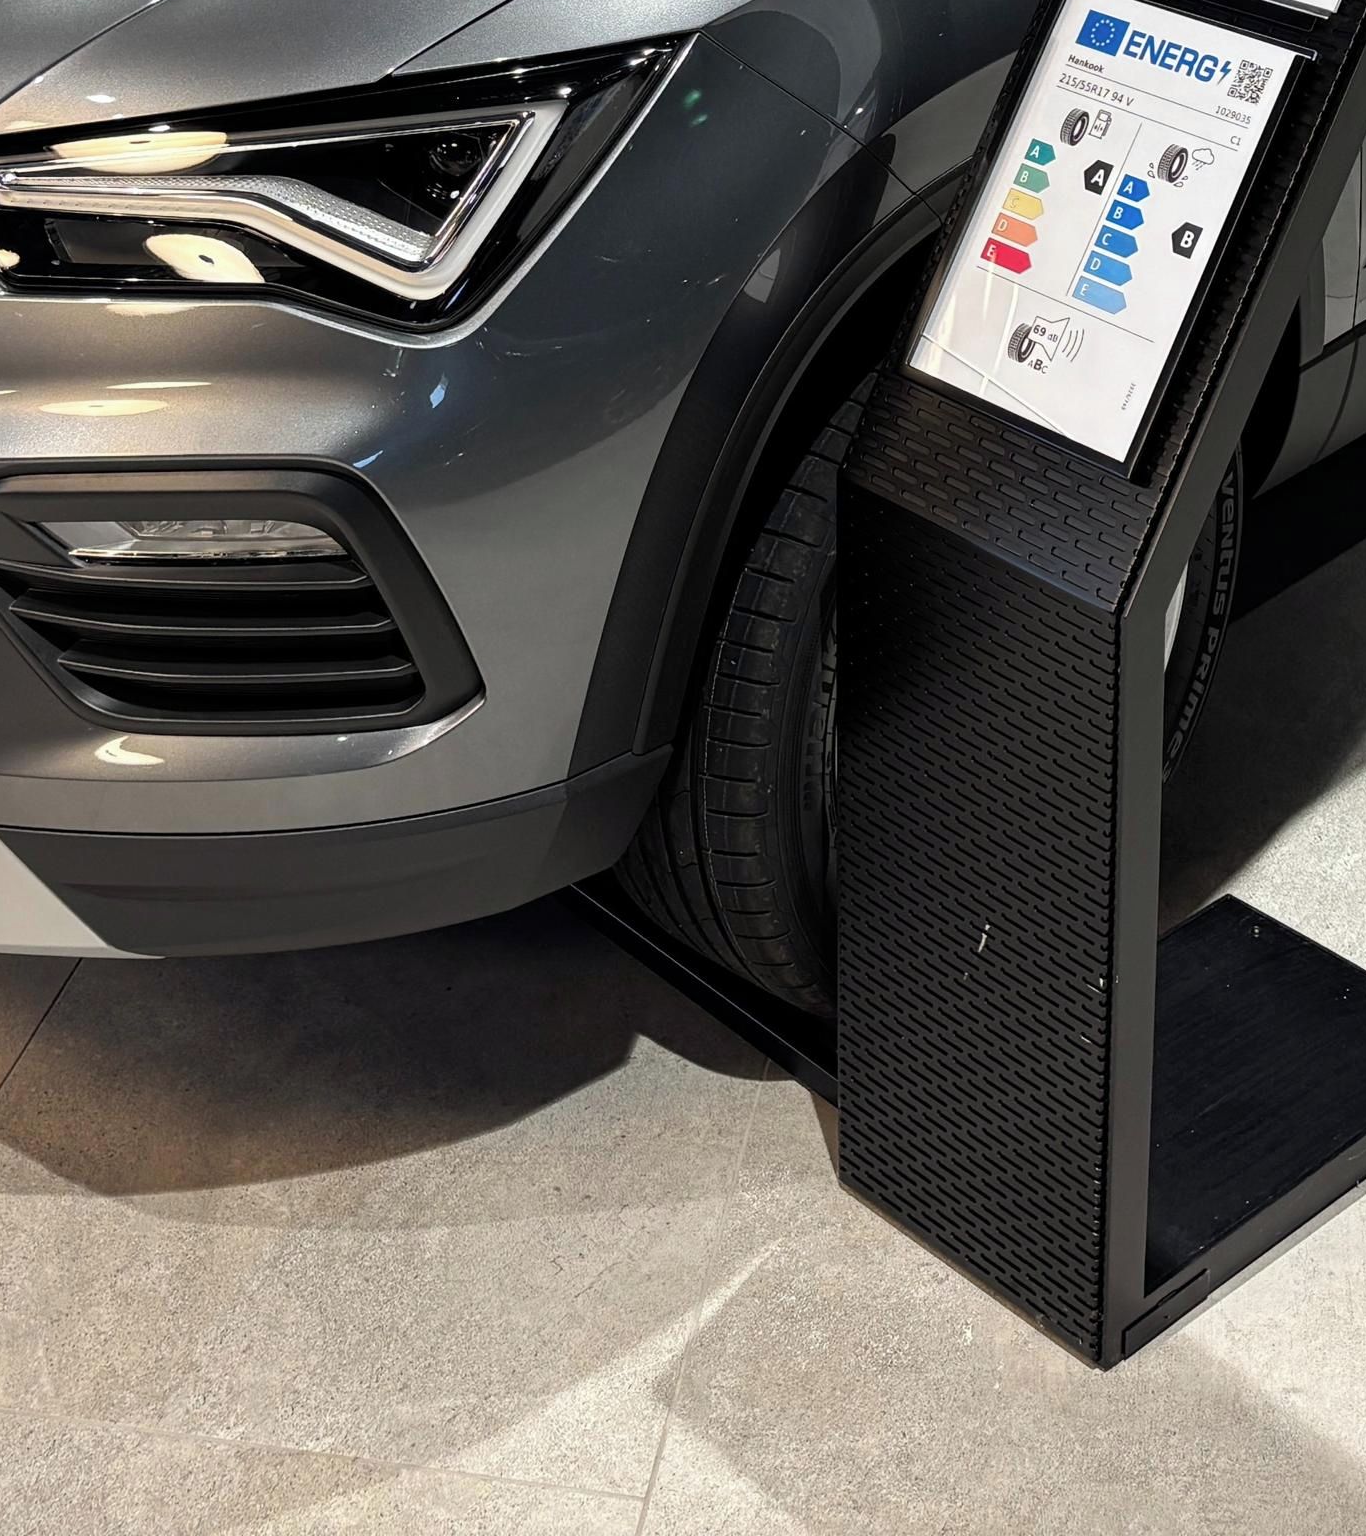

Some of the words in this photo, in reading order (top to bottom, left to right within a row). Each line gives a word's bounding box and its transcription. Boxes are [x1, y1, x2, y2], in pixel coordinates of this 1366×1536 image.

[1068, 54, 1105, 73] Hankook
[1059, 73, 1110, 98] 215/55R17
[1111, 91, 1124, 103] 94
[1126, 97, 1135, 106] V
[1215, 105, 1252, 125] 1029035
[1230, 135, 1242, 146] C1
[1029, 145, 1040, 159] A
[1020, 171, 1029, 183] B
[1091, 169, 1105, 186] A
[1123, 181, 1134, 194] A
[1010, 197, 1020, 209] C
[1113, 206, 1124, 219] B
[997, 220, 1008, 232] D
[1102, 233, 1112, 246] C
[1180, 230, 1195, 248] B
[986, 244, 997, 258] E
[1090, 257, 1101, 270] D
[1080, 283, 1089, 296] E
[1033, 324, 1047, 337] 69
[1047, 332, 1059, 343] dB
